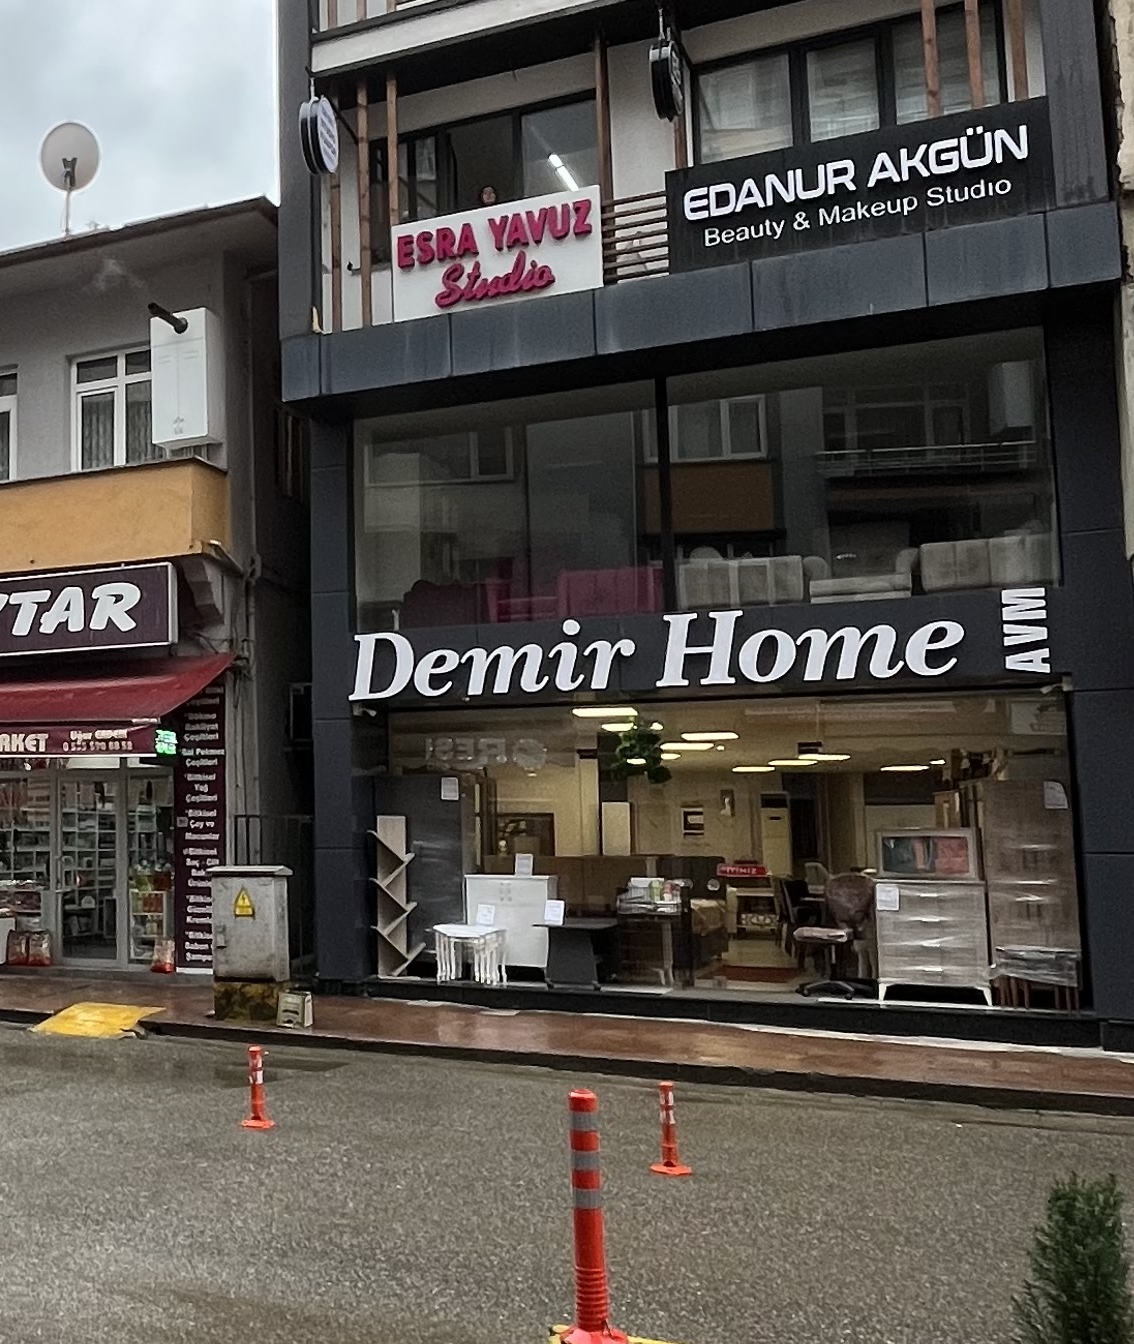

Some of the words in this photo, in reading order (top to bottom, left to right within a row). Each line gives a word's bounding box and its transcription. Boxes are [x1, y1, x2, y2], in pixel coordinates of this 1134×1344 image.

[683, 159, 857, 222] EDANUR
[867, 125, 1030, 189] AKGÜN
[397, 223, 480, 269] ESRA
[487, 199, 593, 252] YAVUZ
[704, 218, 786, 248] Beauty
[792, 211, 811, 232] &
[818, 195, 918, 227] Makeup
[435, 250, 556, 309] Studio
[348, 618, 636, 702] Demir
[655, 609, 966, 688] Home
[1002, 587, 1052, 674] AVM
